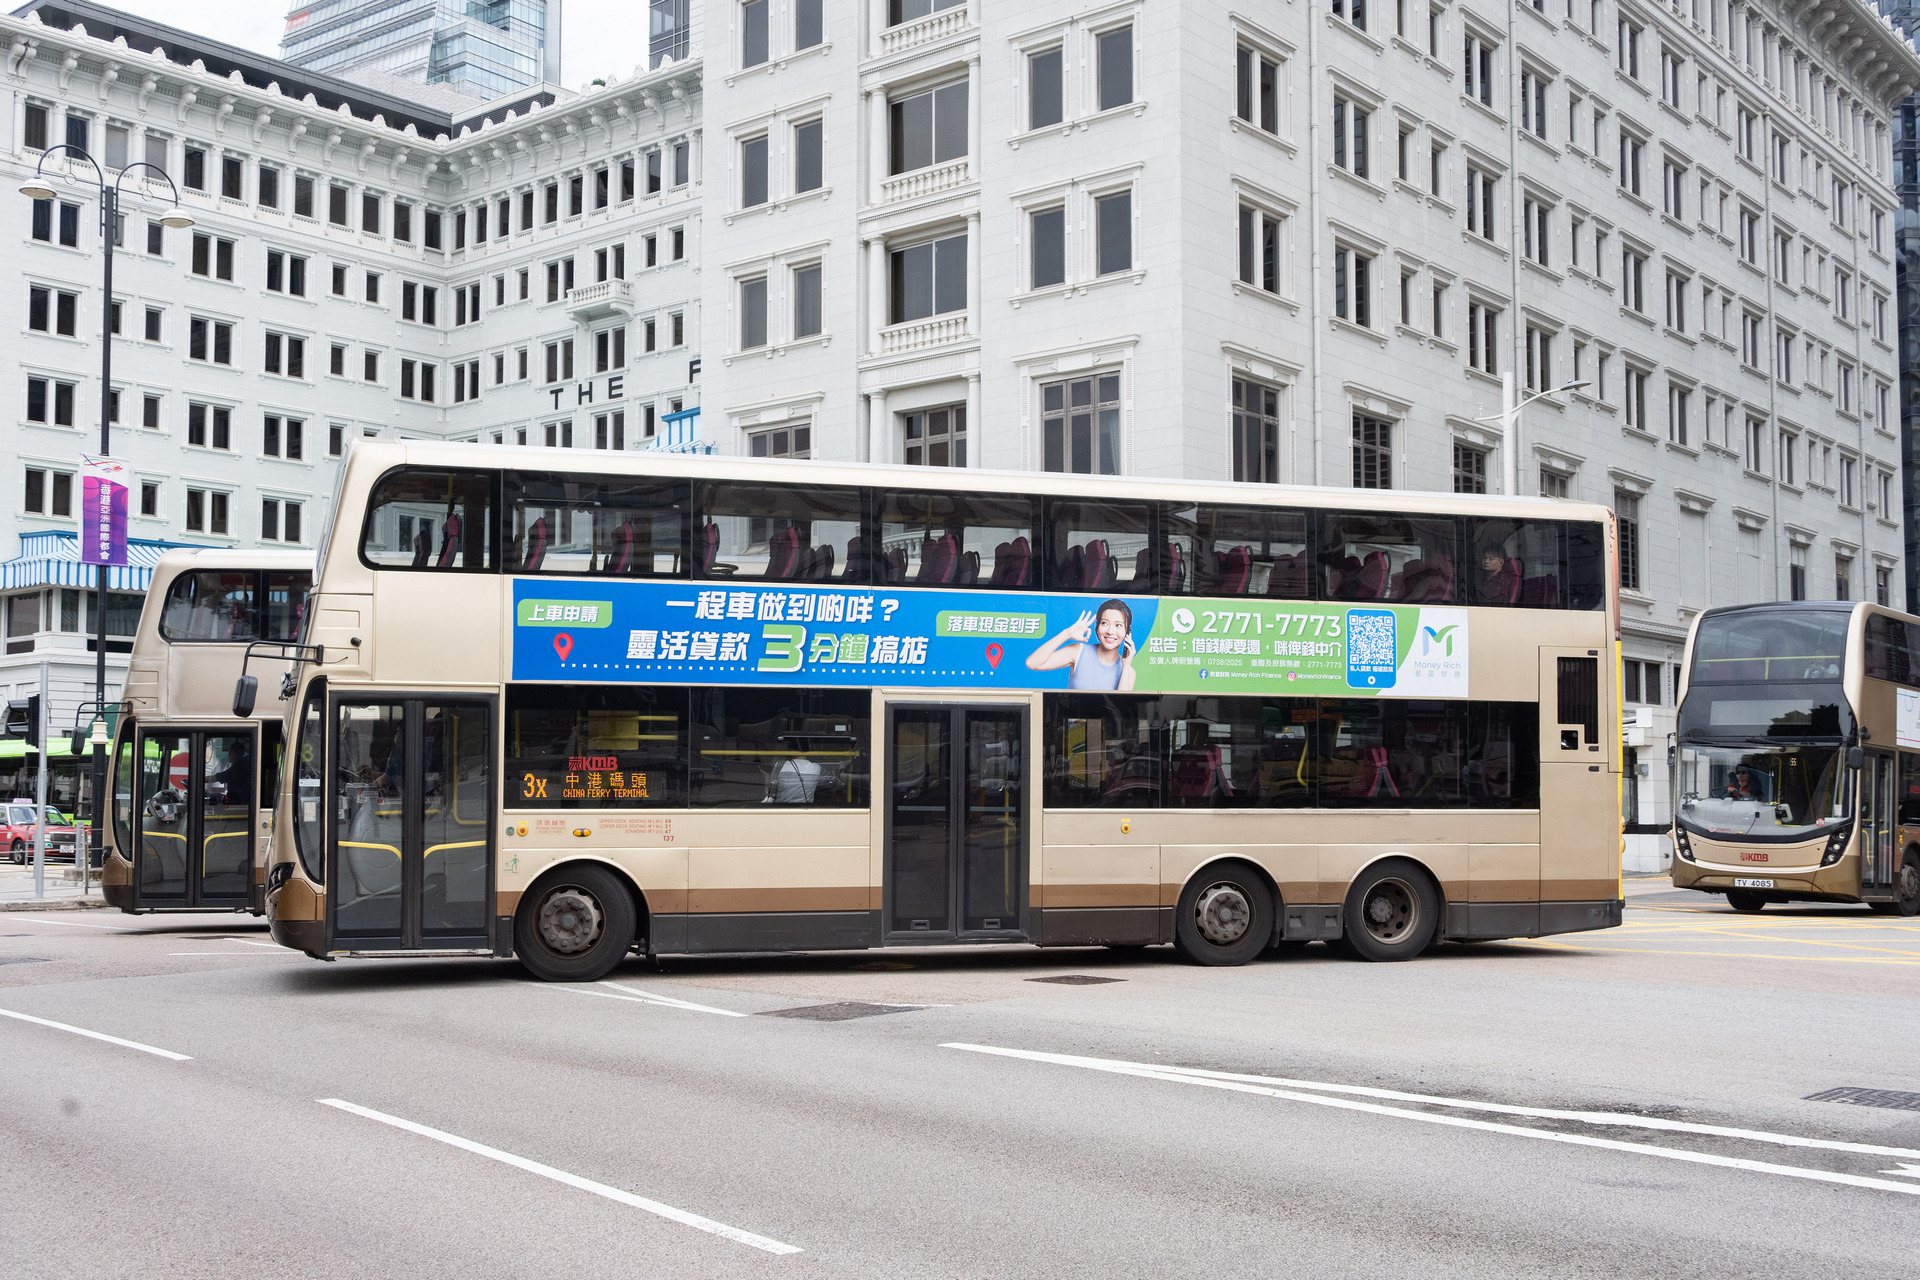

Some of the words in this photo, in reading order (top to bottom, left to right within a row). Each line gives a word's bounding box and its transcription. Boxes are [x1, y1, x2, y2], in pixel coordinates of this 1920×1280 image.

[550, 376, 623, 410] THE
[100, 484, 111, 560] 香港亞洲國際都會
[528, 604, 599, 623] 上車申請
[947, 615, 1040, 635] 落車現金到手
[1202, 611, 1342, 637] 2771-7773
[1414, 661, 1441, 670] Money
[1444, 661, 1461, 670] Rich
[565, 772, 647, 789] 中港碼頭
[563, 789, 586, 798] CHINA
[587, 789, 611, 798] FERRY
[613, 789, 649, 798] TERMINAL
[1748, 853, 1769, 862] KMB
